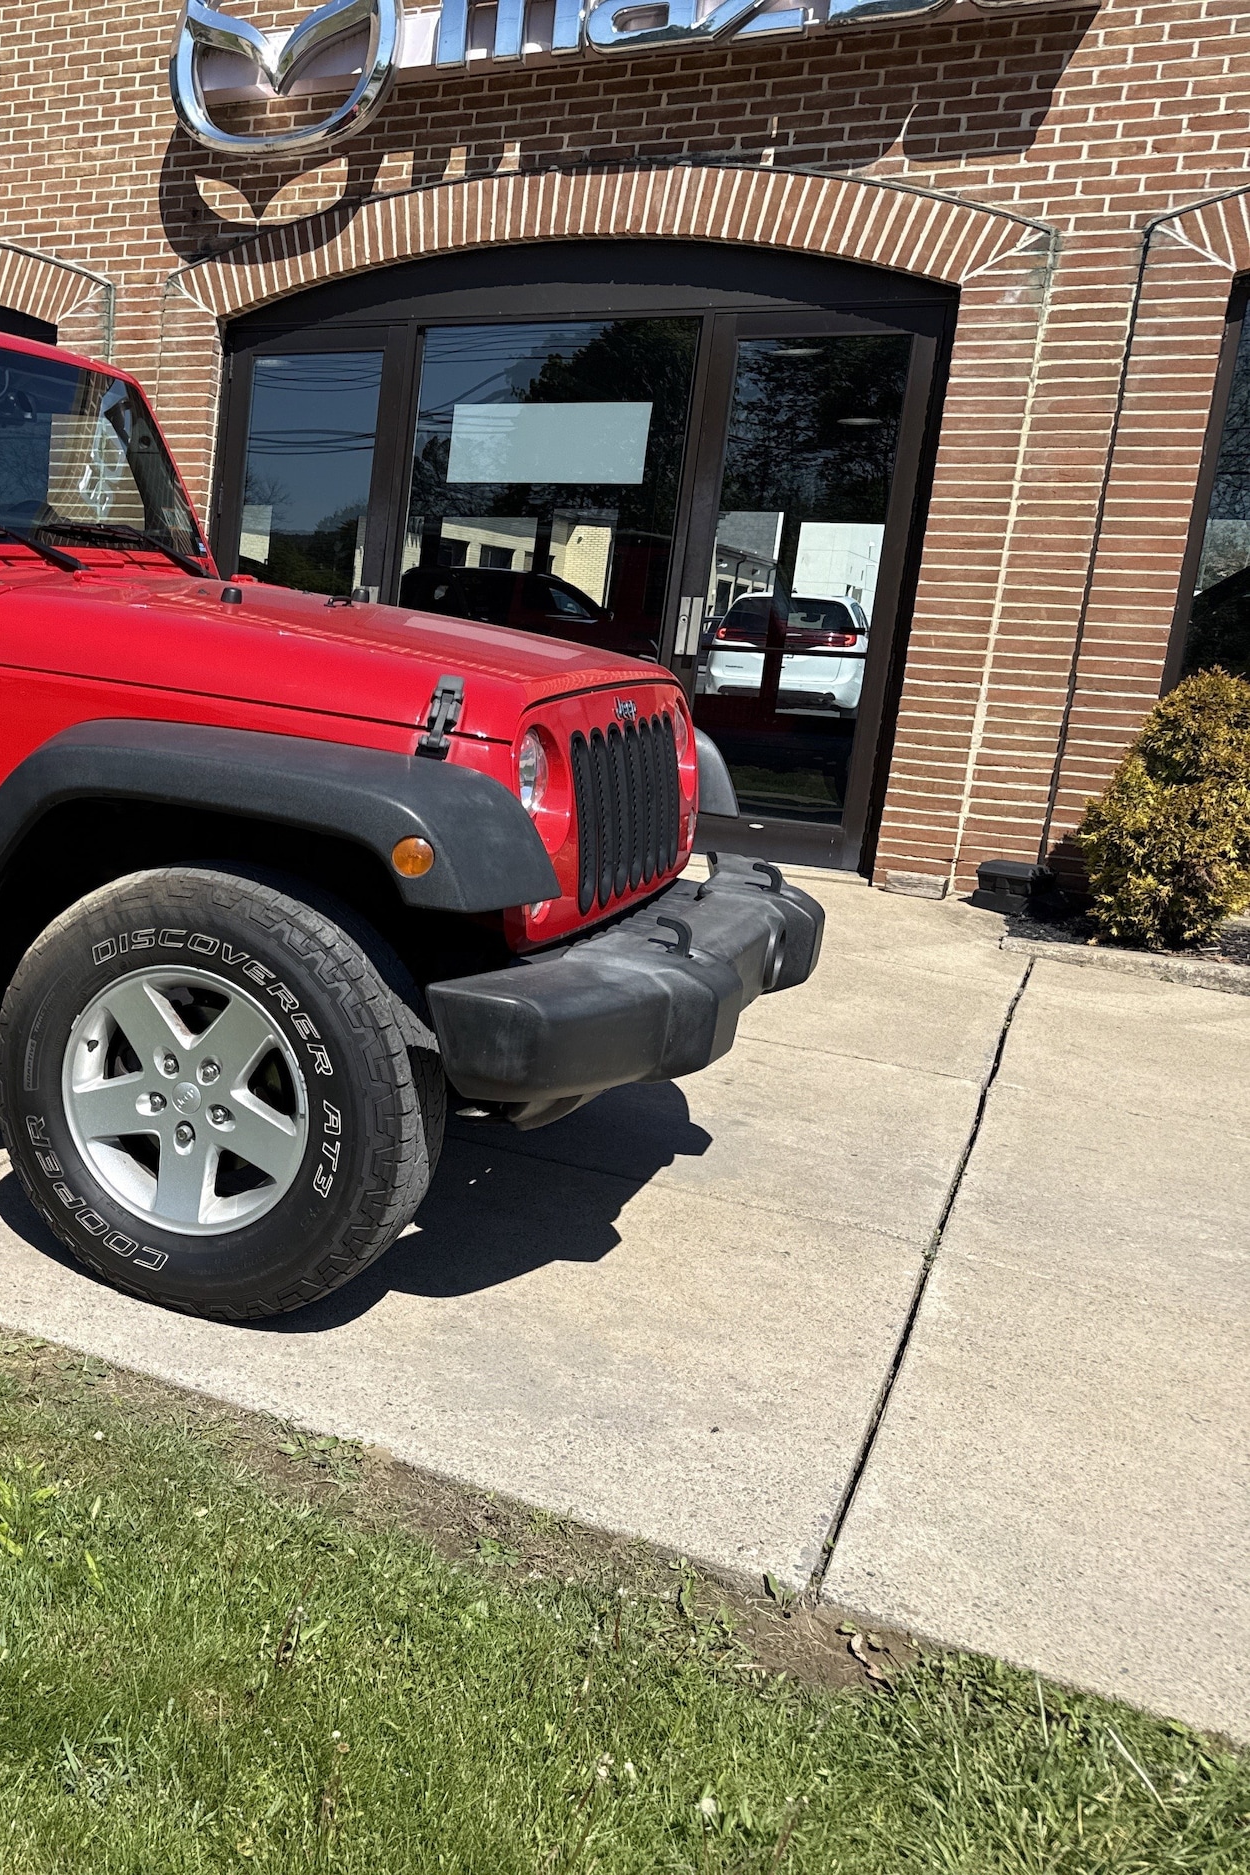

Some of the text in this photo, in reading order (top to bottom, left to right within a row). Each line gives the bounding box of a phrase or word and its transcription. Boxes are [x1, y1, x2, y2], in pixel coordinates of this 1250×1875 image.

[613, 696, 637, 721] Jeep
[90, 928, 334, 1077] DISCOVERER
[312, 1100, 343, 1199] AT3
[24, 1115, 170, 1272] COOPER
